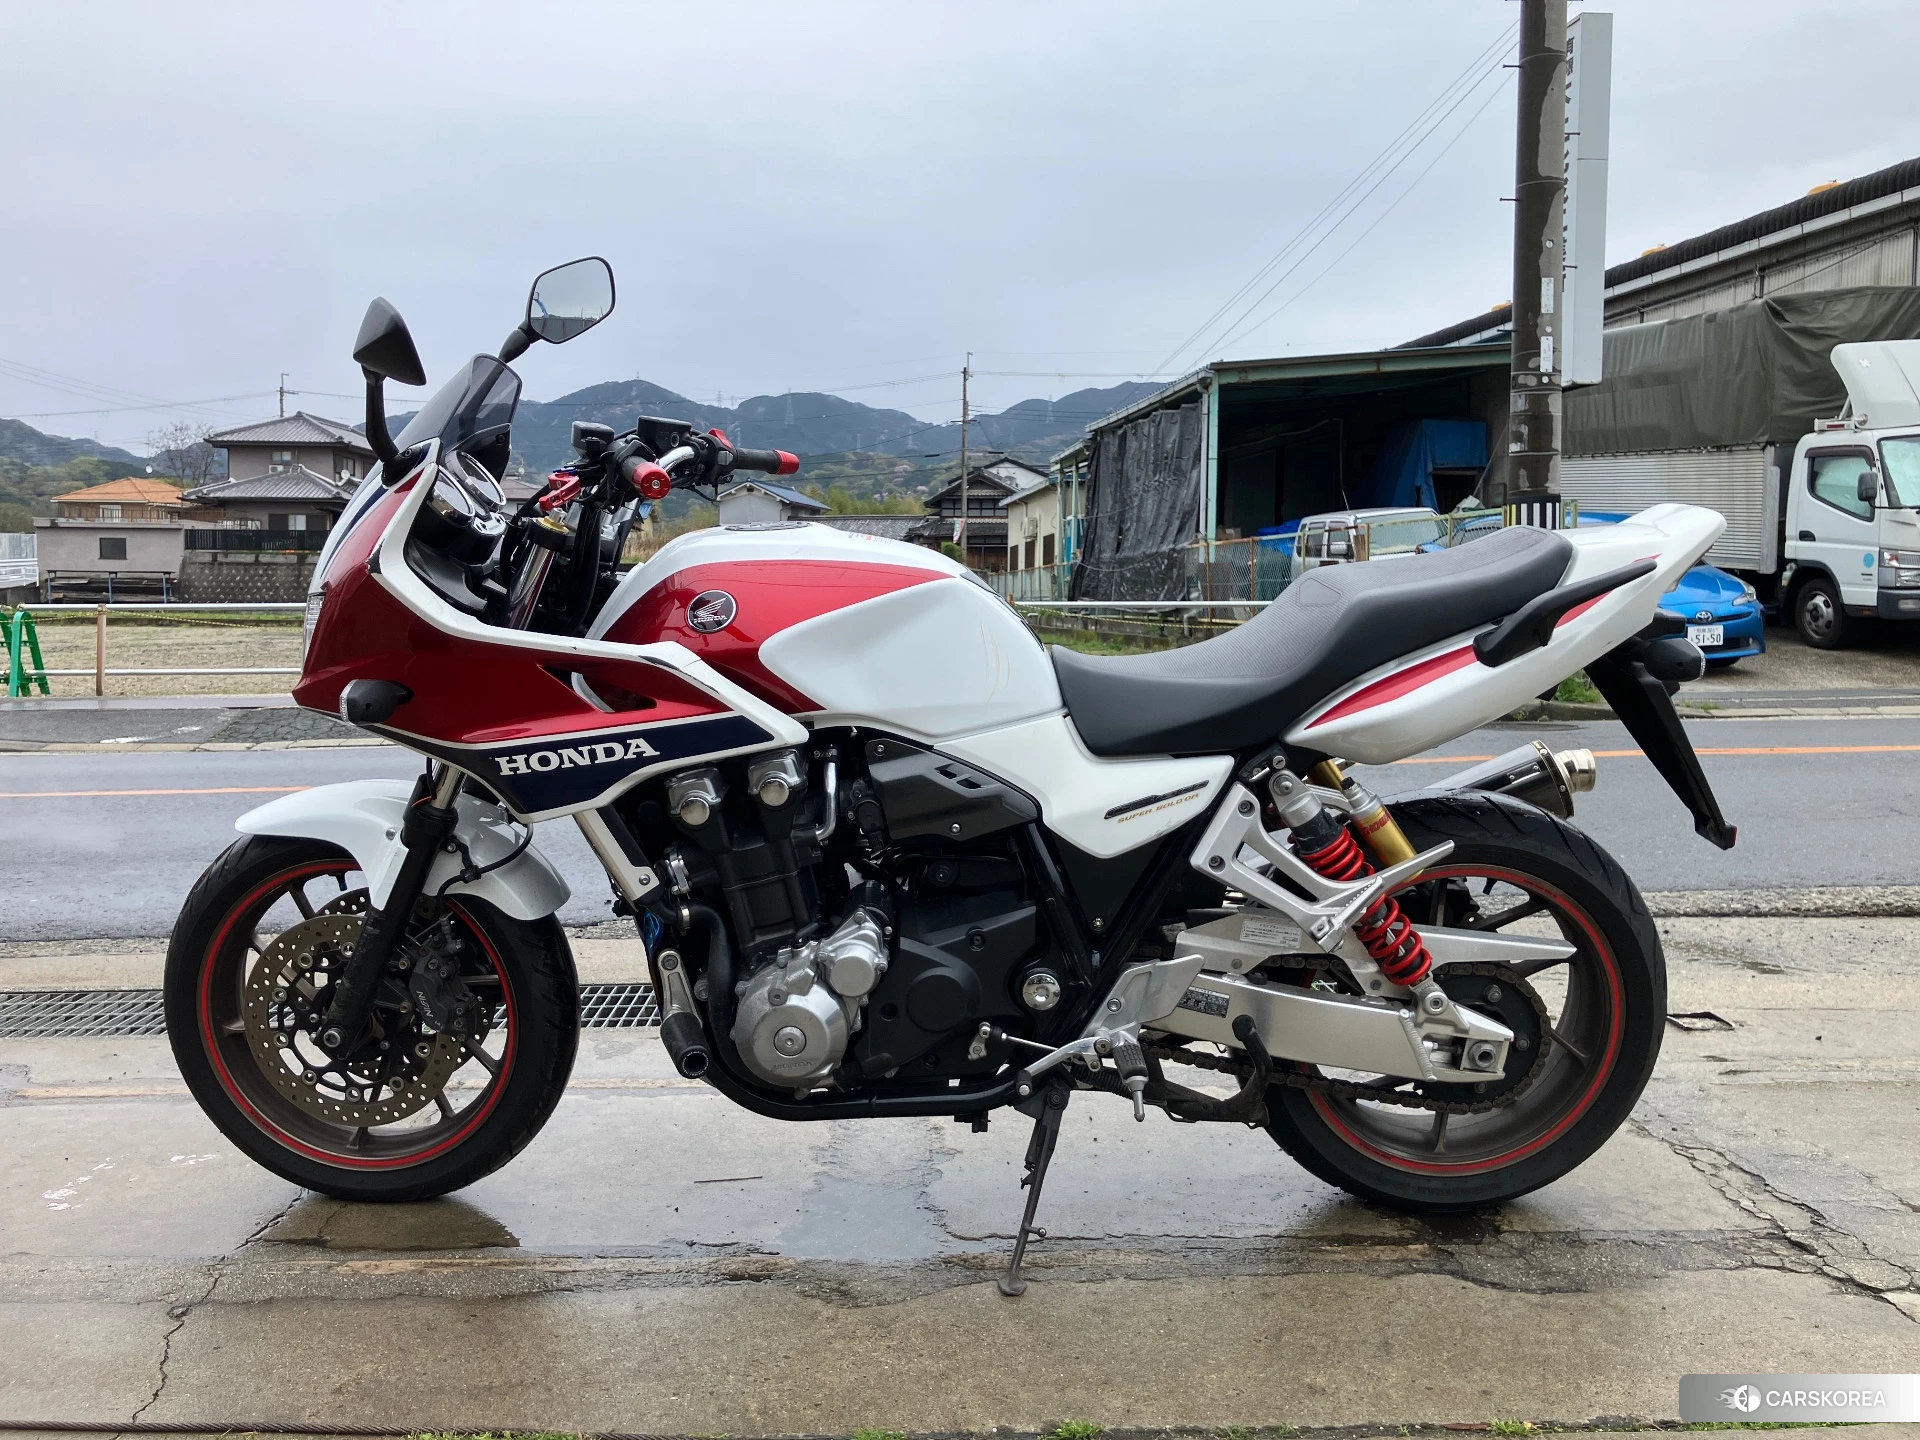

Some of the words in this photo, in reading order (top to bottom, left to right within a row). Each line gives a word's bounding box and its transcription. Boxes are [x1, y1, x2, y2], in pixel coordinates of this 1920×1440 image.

[693, 615, 728, 623] HONDA
[1695, 633, 1721, 644] 51-50
[495, 737, 661, 776] HONDA
[1117, 808, 1153, 824] SUPER
